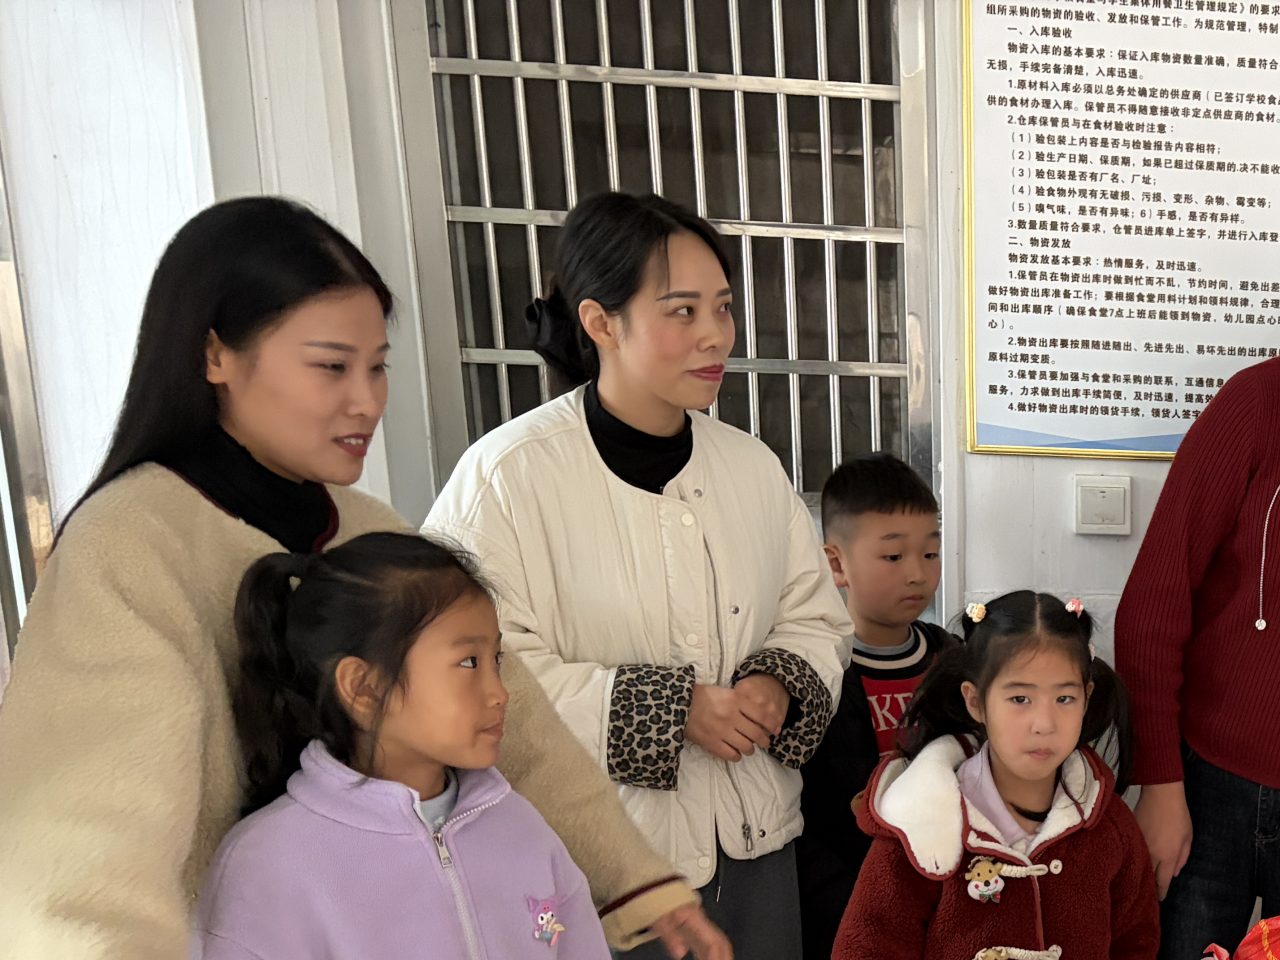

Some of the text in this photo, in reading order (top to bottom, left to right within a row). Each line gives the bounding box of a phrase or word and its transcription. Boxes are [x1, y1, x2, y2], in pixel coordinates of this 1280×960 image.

[1007, 26, 1073, 38] 一、入库验收
[986, 58, 1144, 80] 无损，手续完备清楚，入库迅速。
[1008, 236, 1072, 249] 二、物资发放
[988, 352, 1057, 365] 原料过期变质。
